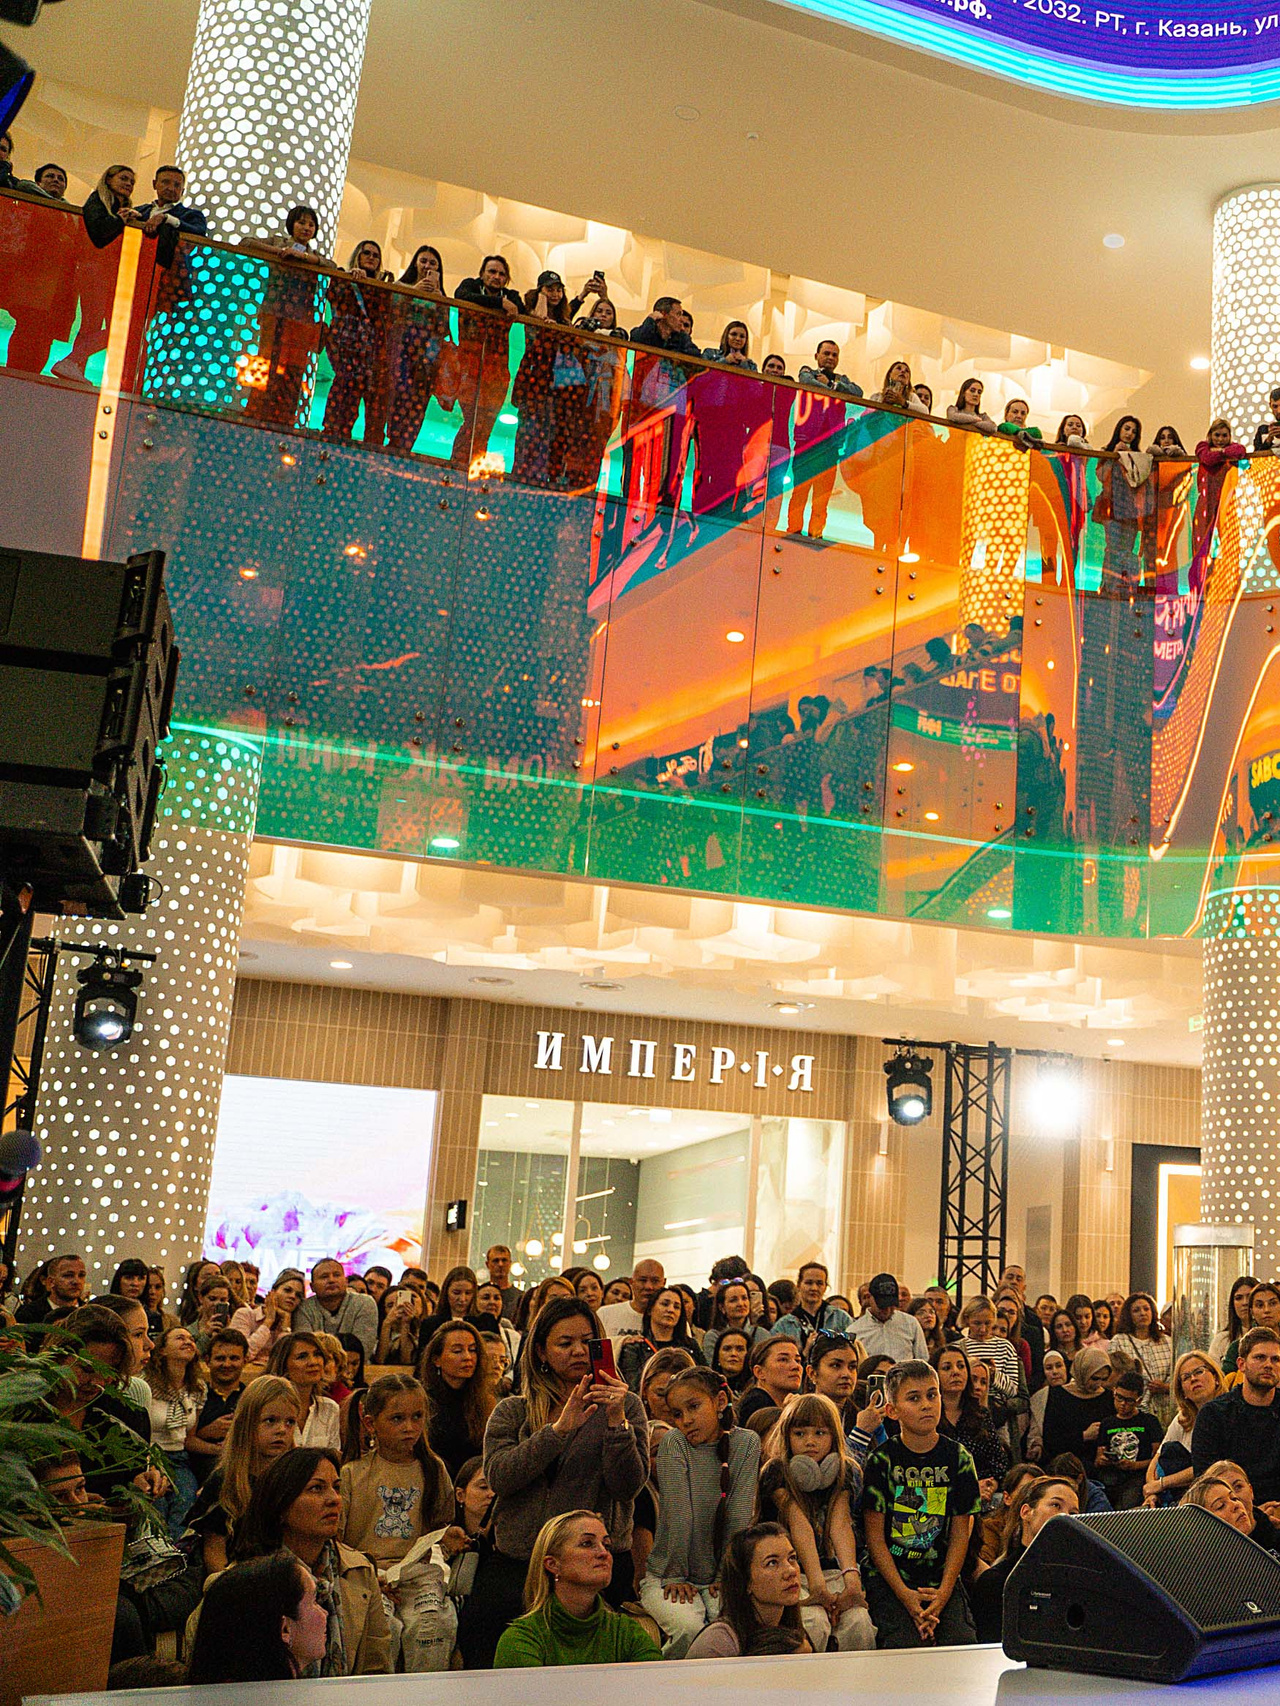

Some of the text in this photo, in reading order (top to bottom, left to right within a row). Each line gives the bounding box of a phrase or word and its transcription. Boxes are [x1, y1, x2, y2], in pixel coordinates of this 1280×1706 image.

[1013, 0, 1087, 25] 2032.
[1095, 10, 1128, 36] РТ,
[1135, 21, 1150, 36] г.
[1158, 19, 1248, 38] Казань,
[893, 1464, 950, 1484] ROCK
